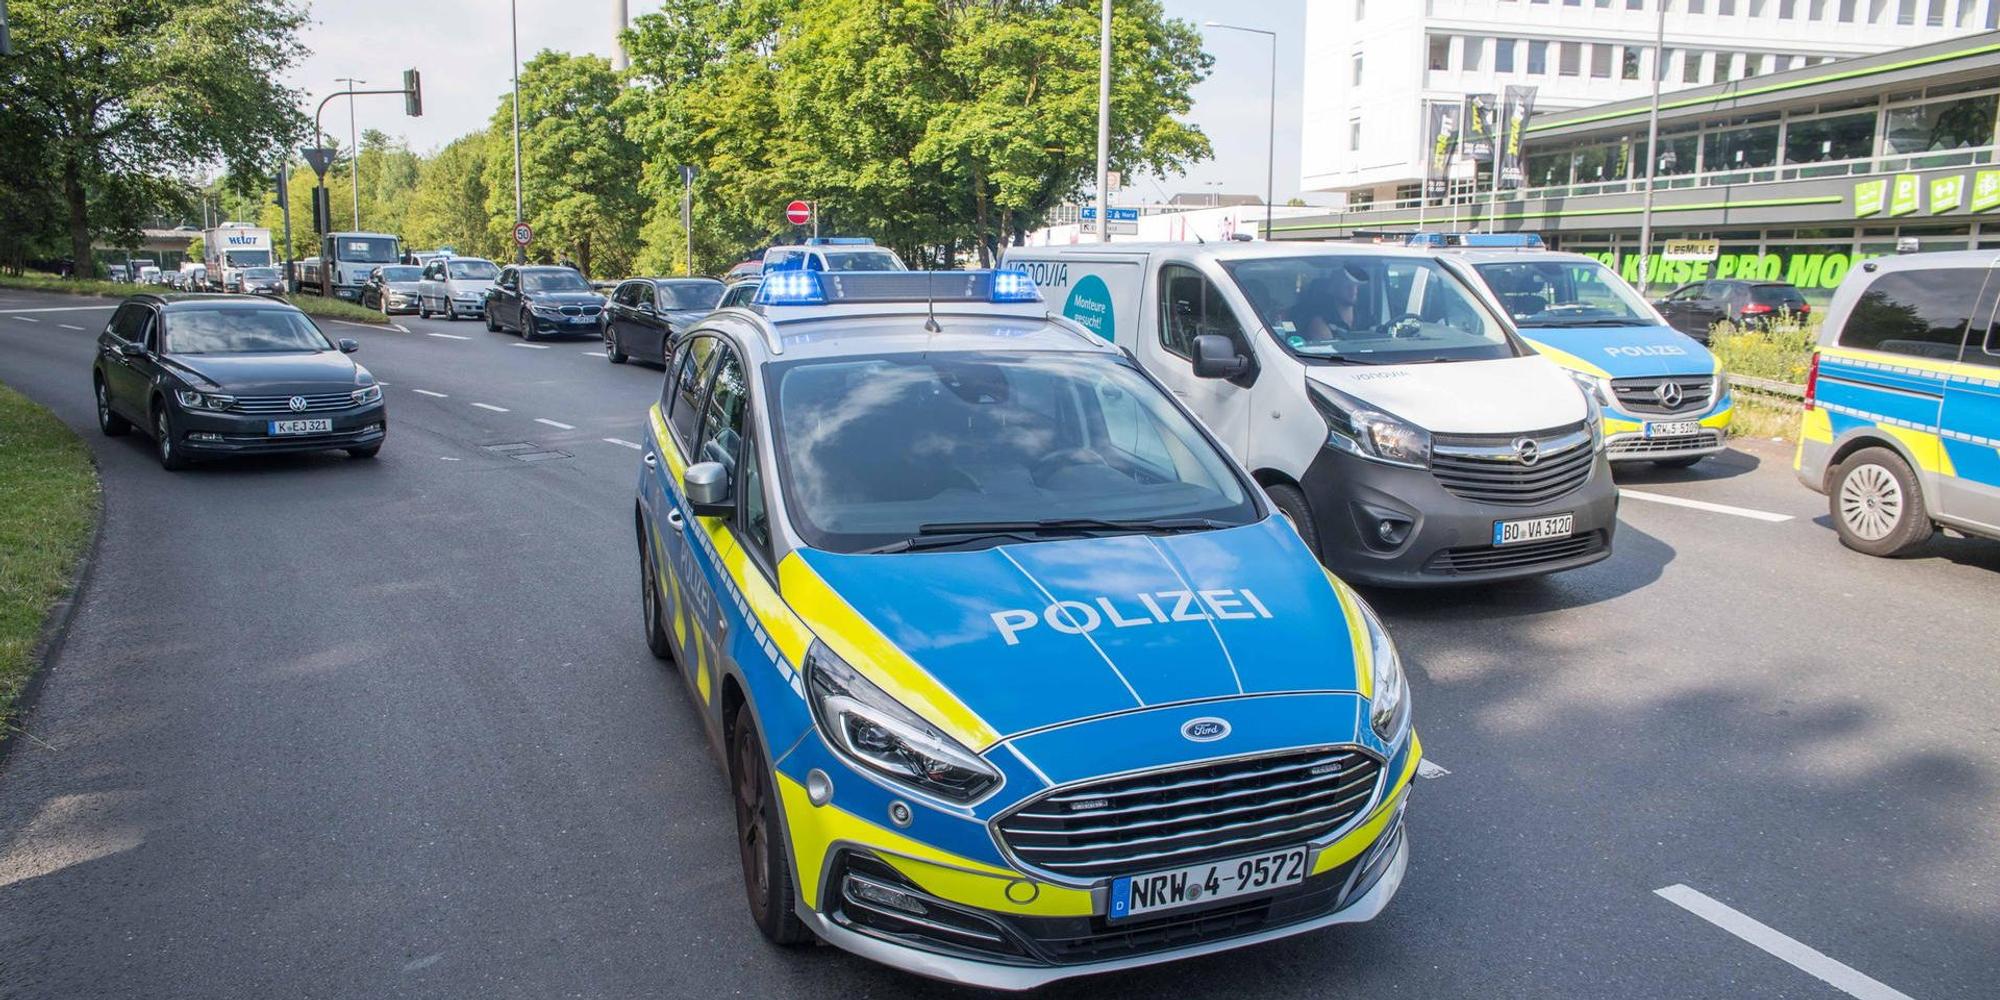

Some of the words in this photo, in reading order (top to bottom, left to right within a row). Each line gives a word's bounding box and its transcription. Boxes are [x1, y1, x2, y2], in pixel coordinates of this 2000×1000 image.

[517, 229, 529, 240] 50
[1714, 254, 1781, 281] PRO
[1074, 294, 1106, 313] Monteure
[1603, 345, 1687, 357] POLIZEI
[279, 422, 286, 432] K
[292, 421, 307, 431] EJ
[309, 420, 327, 430] 321
[1504, 523, 1519, 540] BO
[1528, 520, 1542, 537] VA
[1545, 517, 1571, 535] 3120
[990, 589, 1273, 645] POLIZEI
[1194, 723, 1220, 736] Ford
[1130, 872, 1188, 910] NRW
[1116, 901, 1124, 911] D
